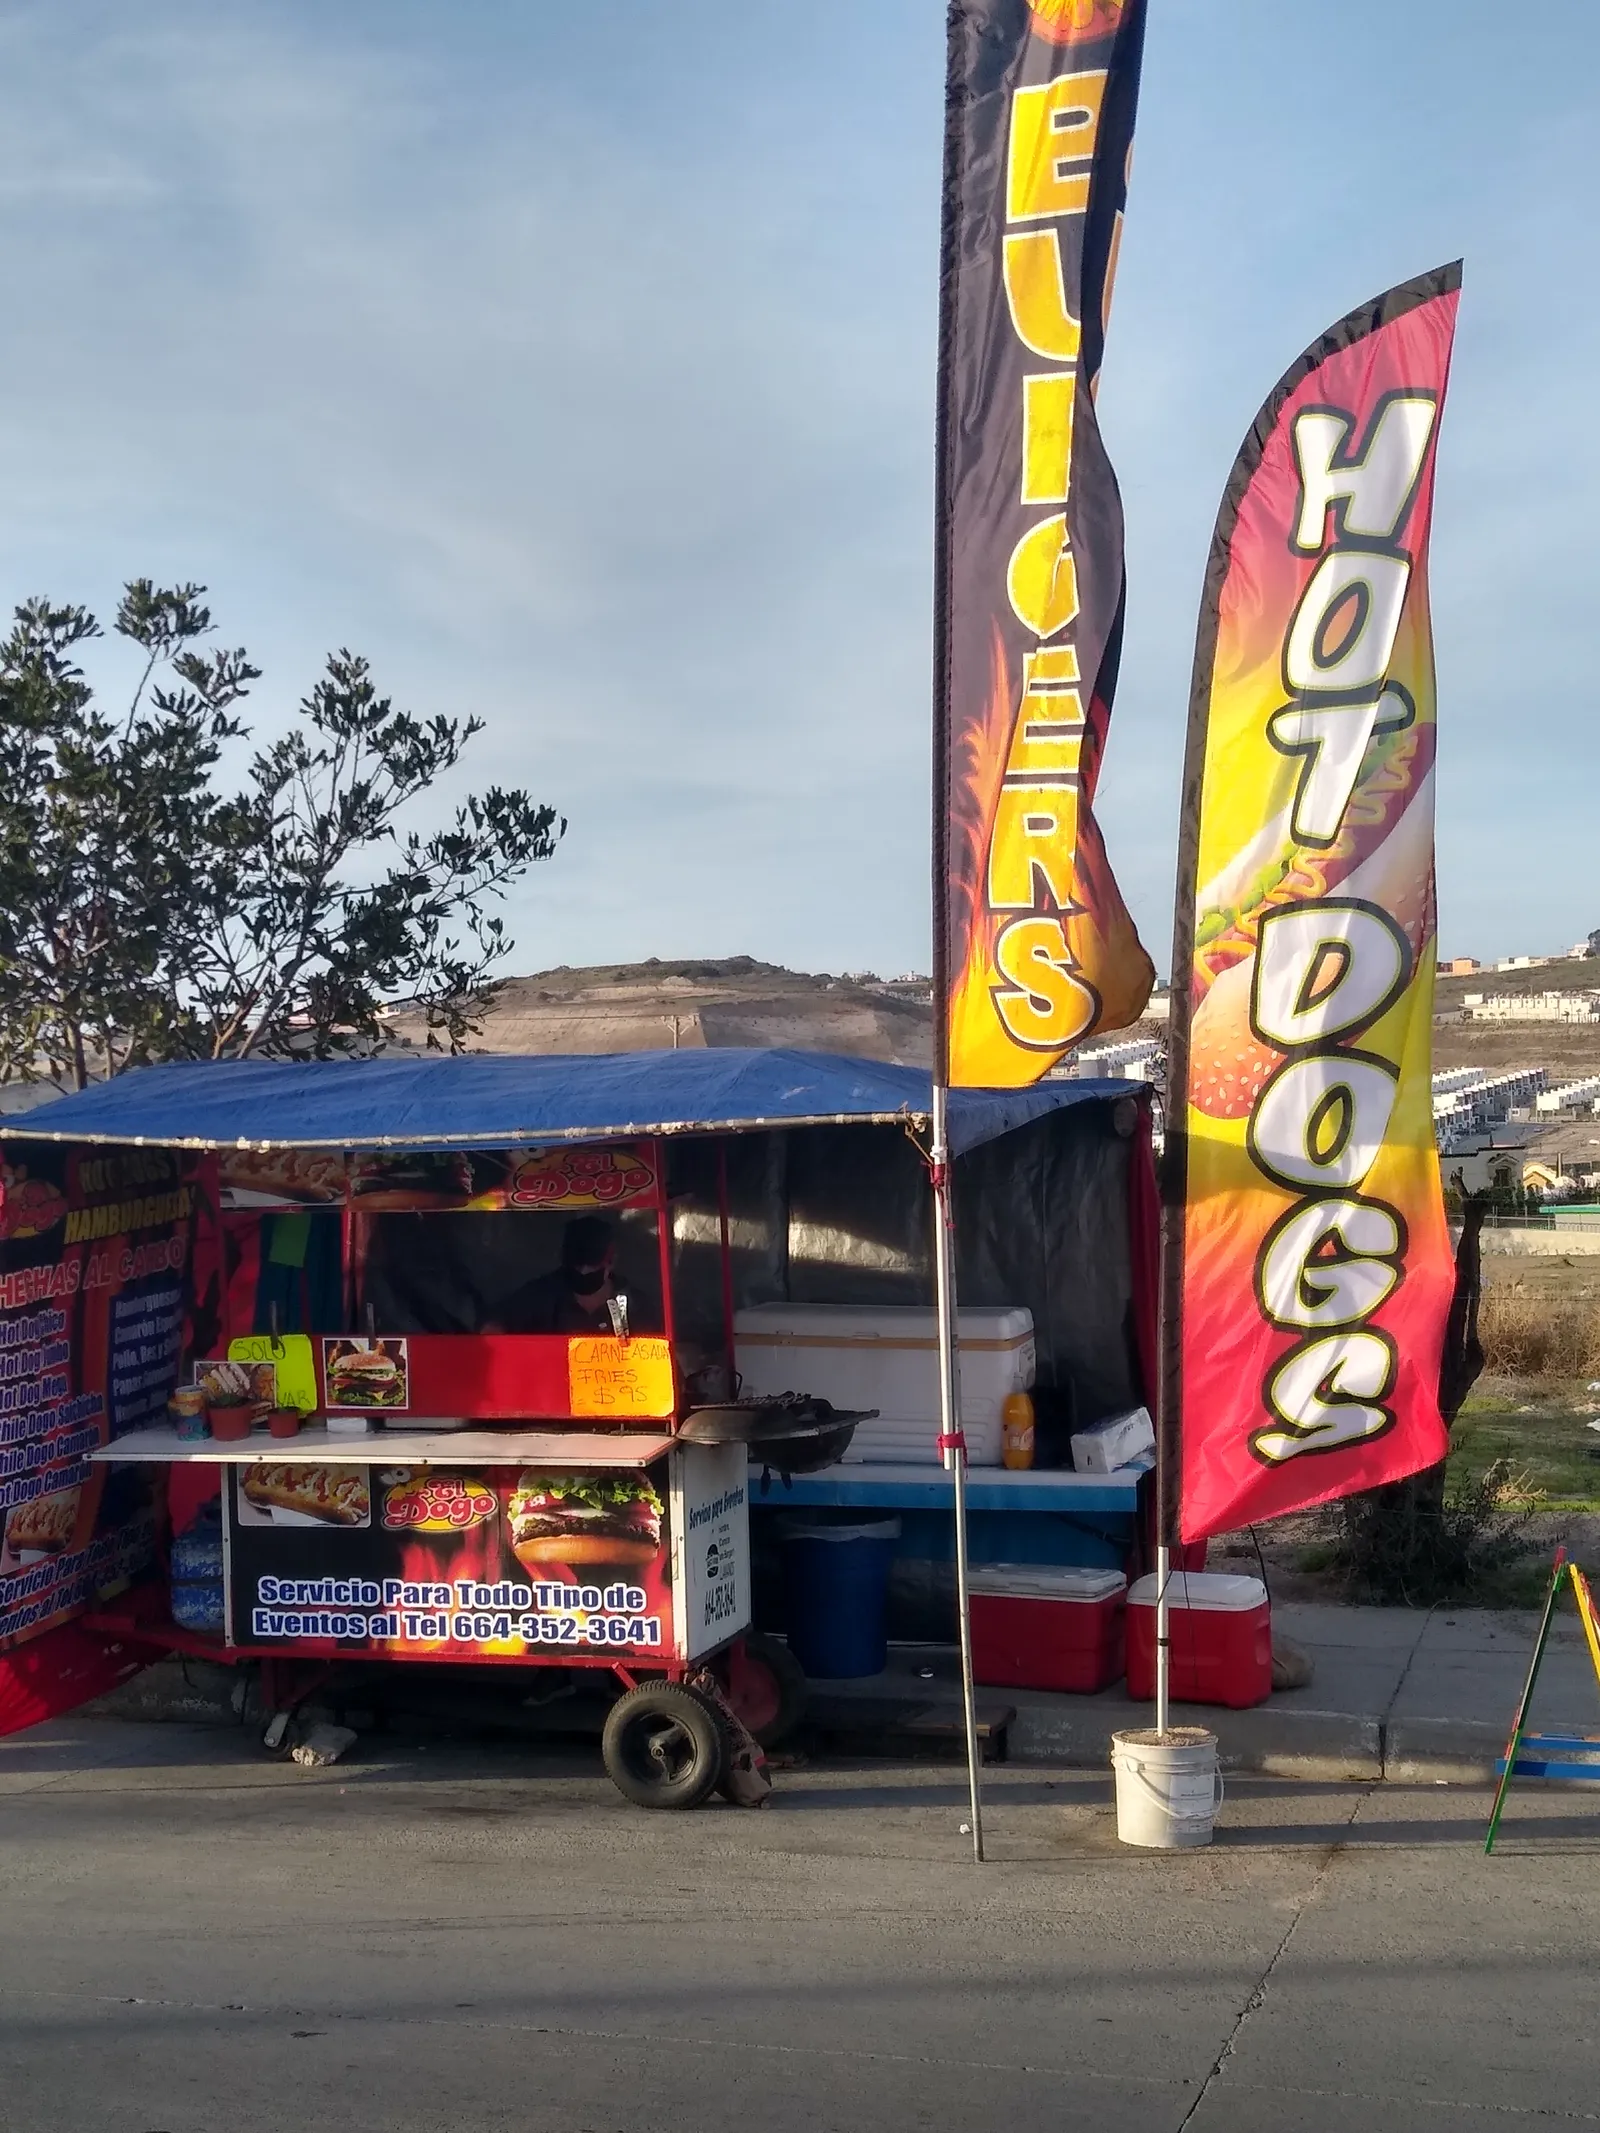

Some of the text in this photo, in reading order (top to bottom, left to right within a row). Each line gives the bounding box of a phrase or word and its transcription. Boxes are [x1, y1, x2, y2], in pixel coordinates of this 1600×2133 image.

[1249, 388, 1438, 1469] HOT DOGS
[513, 1162, 653, 1207] Dogo
[63, 1186, 195, 1245] HAMBURGUESA
[0, 1259, 81, 1310] HECHAS
[83, 1253, 112, 1290] AL
[21, 1349, 41, 1375] Dog
[574, 1341, 631, 1364] CARNE
[576, 1368, 639, 1385] FRIES
[19, 1380, 40, 1407] Dog
[27, 1409, 56, 1436] Dogo
[25, 1441, 55, 1470] Dogo
[13, 1475, 42, 1505] Dogo
[425, 1476, 466, 1500] El
[383, 1490, 495, 1529] Dogo
[0, 1561, 55, 1606] Servicio
[257, 1576, 647, 1613] Servicio Para Todo Tipo de
[252, 1609, 661, 1646] Eventos al Tel 664-352-3641
